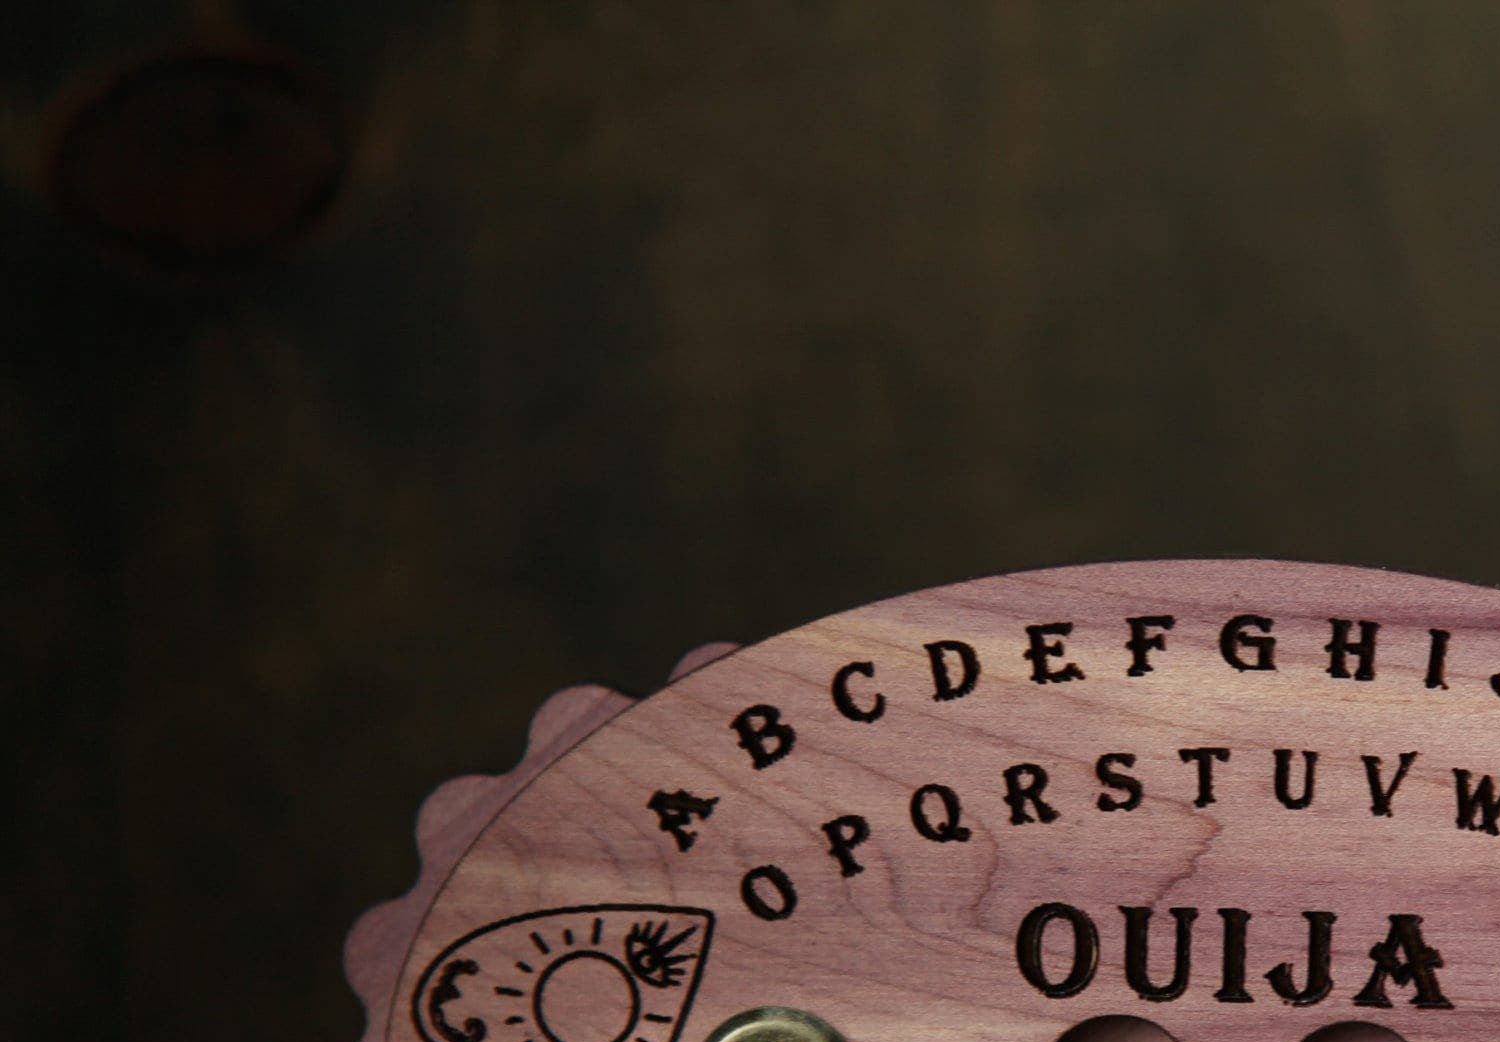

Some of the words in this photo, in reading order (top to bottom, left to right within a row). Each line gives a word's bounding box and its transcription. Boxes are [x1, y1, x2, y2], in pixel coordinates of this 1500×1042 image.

[646, 788, 720, 853] A
[728, 703, 797, 771] B
[830, 661, 887, 725] C
[922, 639, 982, 703] D
[1022, 621, 1086, 685] E
[1124, 614, 1179, 678] F
[1217, 613, 1277, 673] G
[1323, 614, 1383, 682] H
[1423, 627, 1452, 691] I
[739, 864, 798, 922] O
[820, 814, 871, 879] P
[909, 782, 973, 844] Q
[1002, 762, 1062, 827] R
[1094, 752, 1146, 813] S
[1177, 747, 1231, 809] T
[1272, 748, 1320, 811] U
[1359, 750, 1420, 819] V
[1014, 901, 1456, 1011] OUIJA
